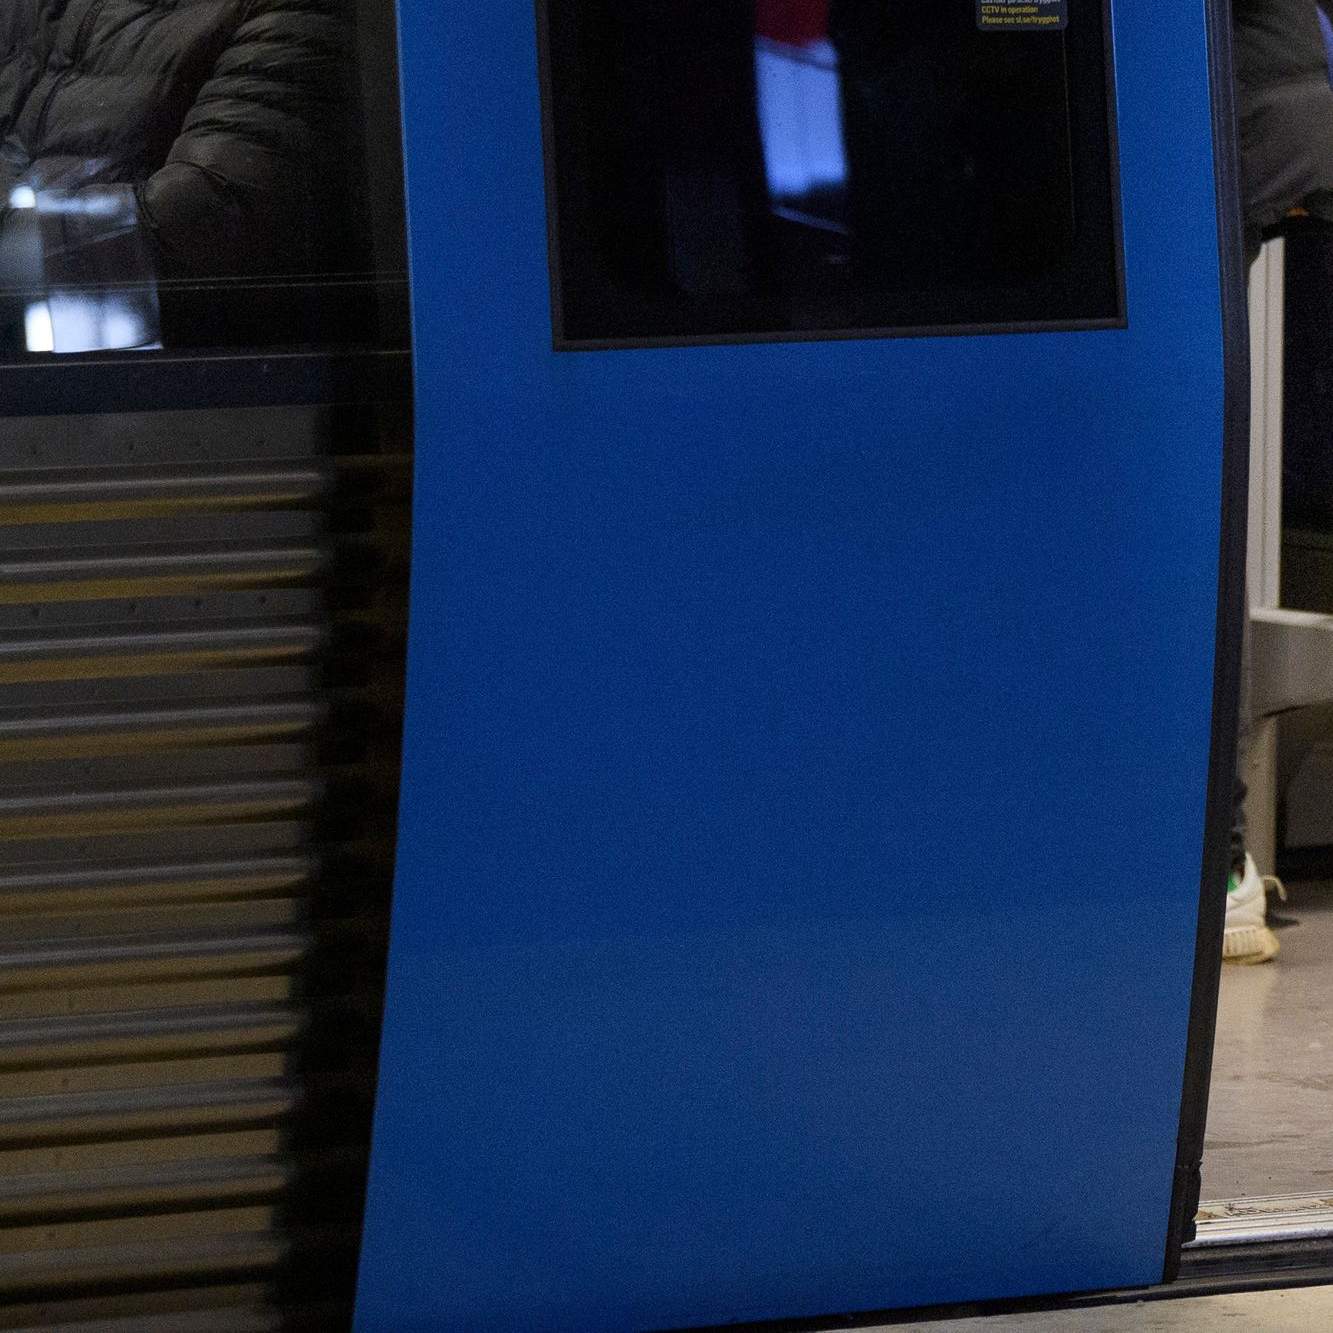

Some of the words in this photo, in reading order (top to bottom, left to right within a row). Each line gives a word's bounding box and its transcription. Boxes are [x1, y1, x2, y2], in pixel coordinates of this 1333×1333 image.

[981, 5, 999, 13] CCTV
[1008, 6, 1038, 15] operation
[982, 16, 1003, 24] Please
